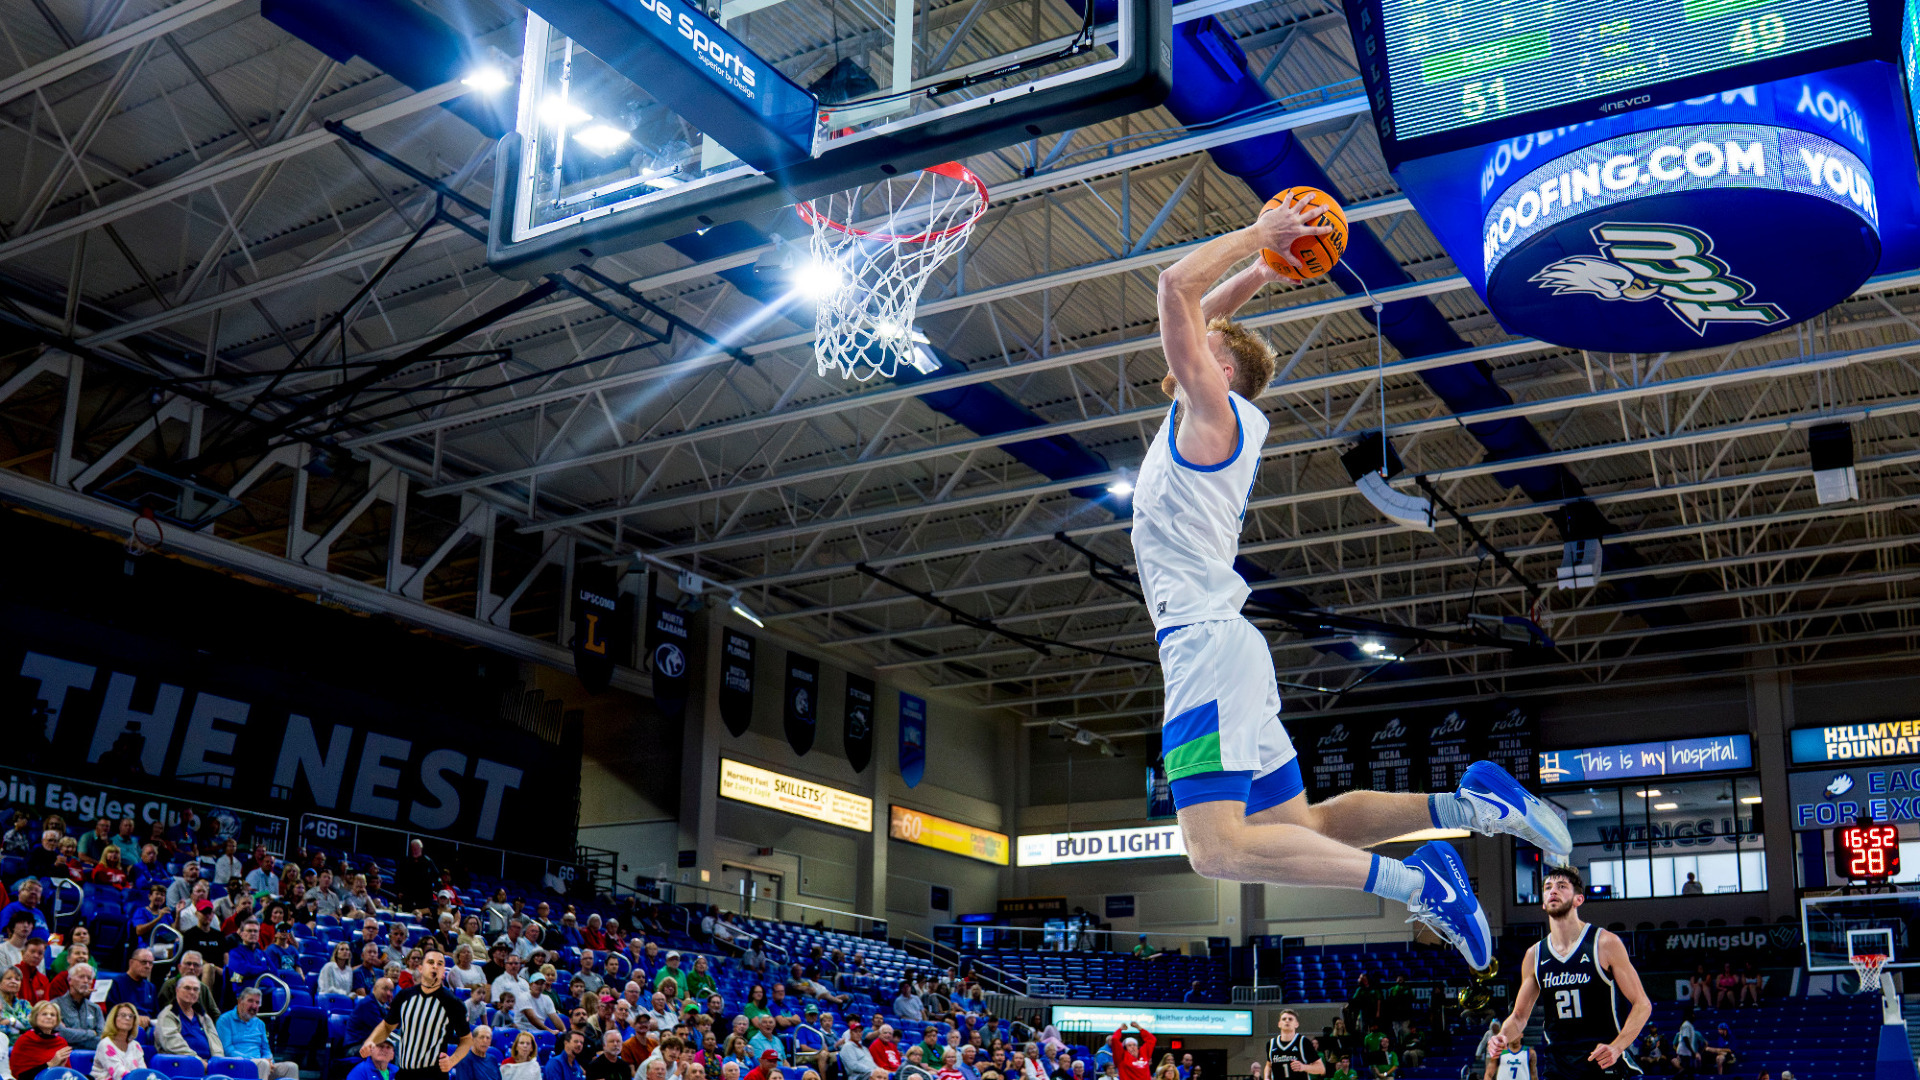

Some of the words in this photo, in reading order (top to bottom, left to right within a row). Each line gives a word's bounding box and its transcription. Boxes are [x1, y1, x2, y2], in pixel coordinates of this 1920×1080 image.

[1729, 13, 1787, 55] 49
[677, 13, 756, 87] Sports
[698, 50, 725, 77] Superior
[725, 70, 734, 84] by
[733, 78, 755, 99] Design
[1461, 77, 1507, 118] 51
[1608, 95, 1651, 112] NEVCO
[584, 613, 606, 655] L
[19, 650, 252, 789] THE
[270, 712, 525, 842] NEST
[1574, 752, 1613, 772] This
[1620, 750, 1634, 769] is
[1641, 751, 1666, 775] my
[1671, 737, 1738, 769] hospital.
[724, 779, 734, 788] for
[727, 770, 754, 785] Morning
[774, 779, 819, 802] SKILLETS
[44, 782, 136, 822] Eagles
[1797, 800, 1859, 827] FOR
[316, 821, 338, 840] GG
[902, 813, 922, 840] 60
[1597, 818, 1716, 852] WINGS
[1844, 828, 1895, 848] 16:52
[1056, 837, 1103, 857] BUD
[1108, 831, 1175, 854] LIGHT
[1851, 848, 1885, 874] 28
[1665, 932, 1767, 950] #WingsUp
[1543, 971, 1591, 988] Hatters
[1555, 989, 1583, 1019] 21
[1156, 1014, 1184, 1023] Neither
[1185, 1014, 1208, 1023] should
[1209, 1015, 1226, 1024] you.
[1282, 1063, 1289, 1078] 1
[1510, 1067, 1518, 1079] 7
